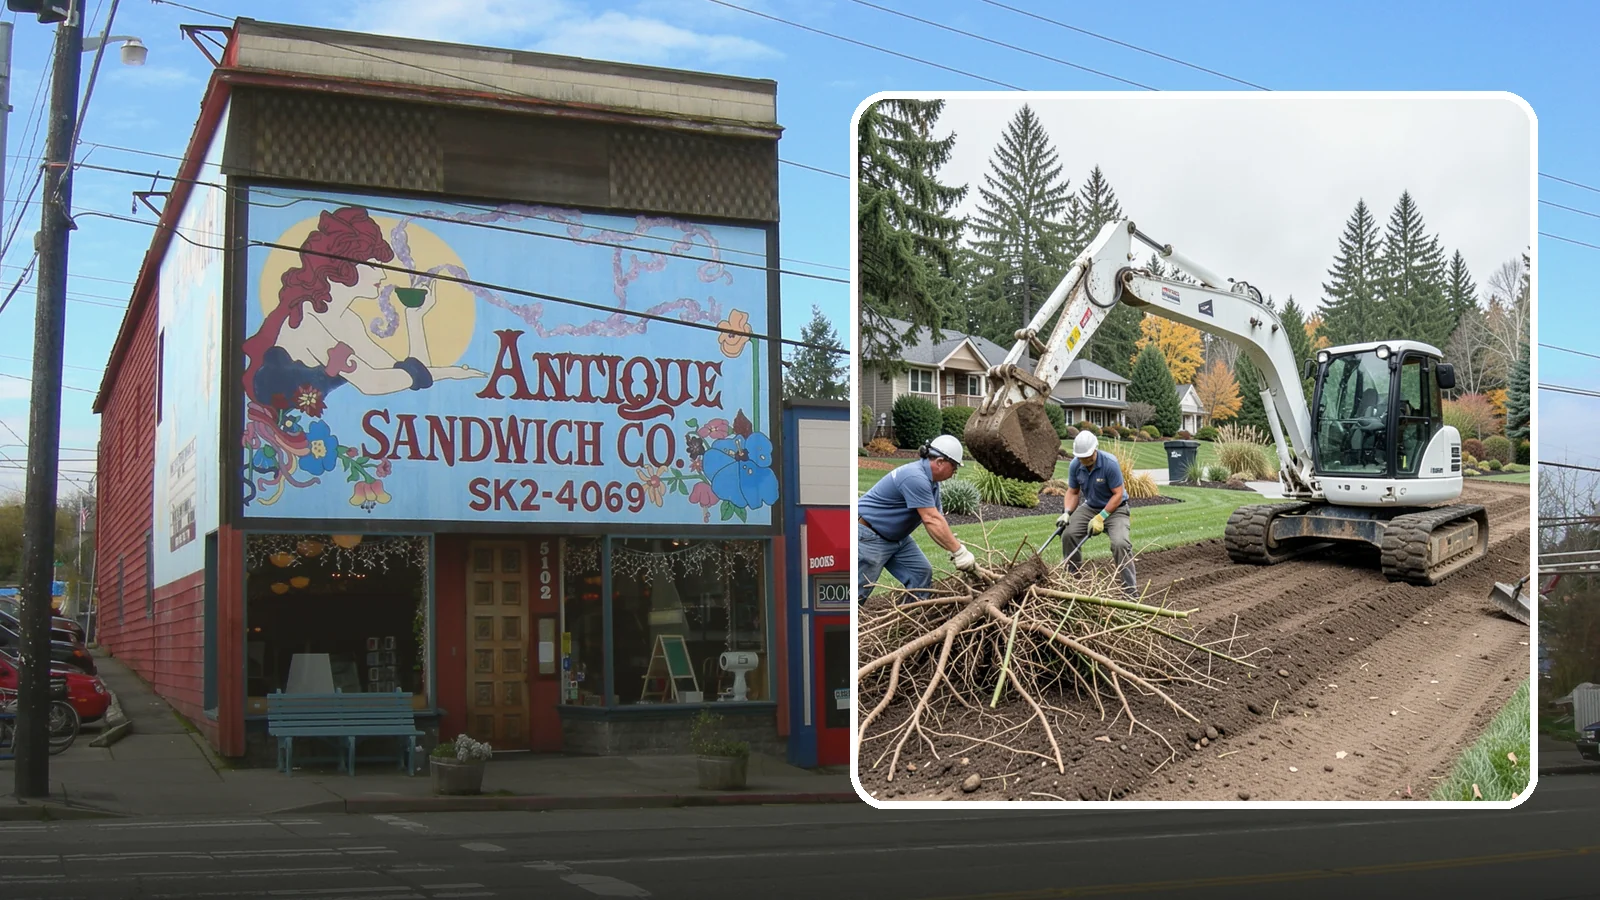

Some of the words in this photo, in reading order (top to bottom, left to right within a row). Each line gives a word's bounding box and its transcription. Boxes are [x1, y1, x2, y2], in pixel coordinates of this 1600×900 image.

[476, 329, 722, 421] ANTIQUE
[361, 409, 604, 467] SANDWICH
[617, 422, 685, 468] CO.
[468, 478, 645, 513] SK2-4069
[540, 542, 551, 599] 5102
[810, 555, 834, 568] BOOKS
